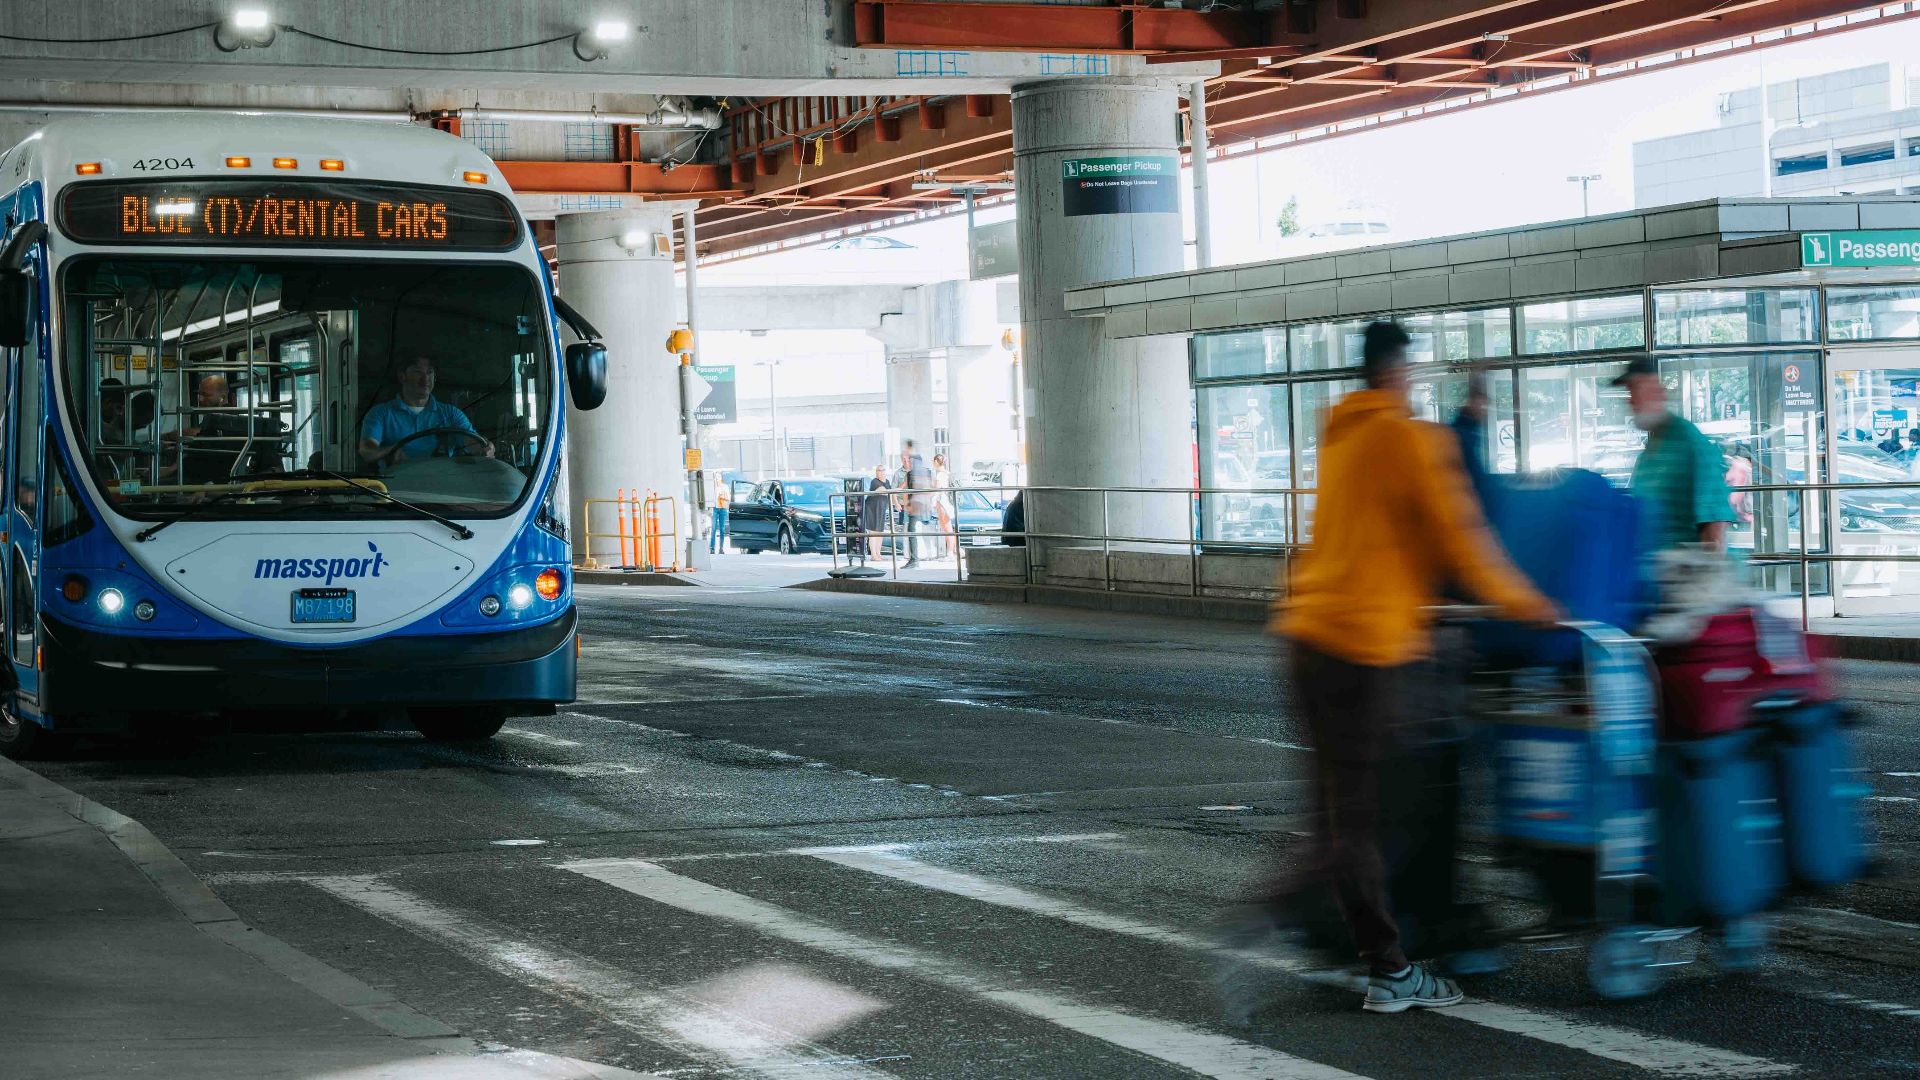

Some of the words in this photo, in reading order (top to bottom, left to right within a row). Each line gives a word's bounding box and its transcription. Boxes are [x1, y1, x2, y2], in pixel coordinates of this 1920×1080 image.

[133, 157, 195, 171] 4204
[1080, 162, 1132, 173] Passenger
[1134, 161, 1162, 171] Pickup
[123, 196, 192, 233] BLUE
[204, 198, 365, 237] (T)/RENTAL
[377, 202, 447, 239] CARS
[254, 552, 383, 586] massport
